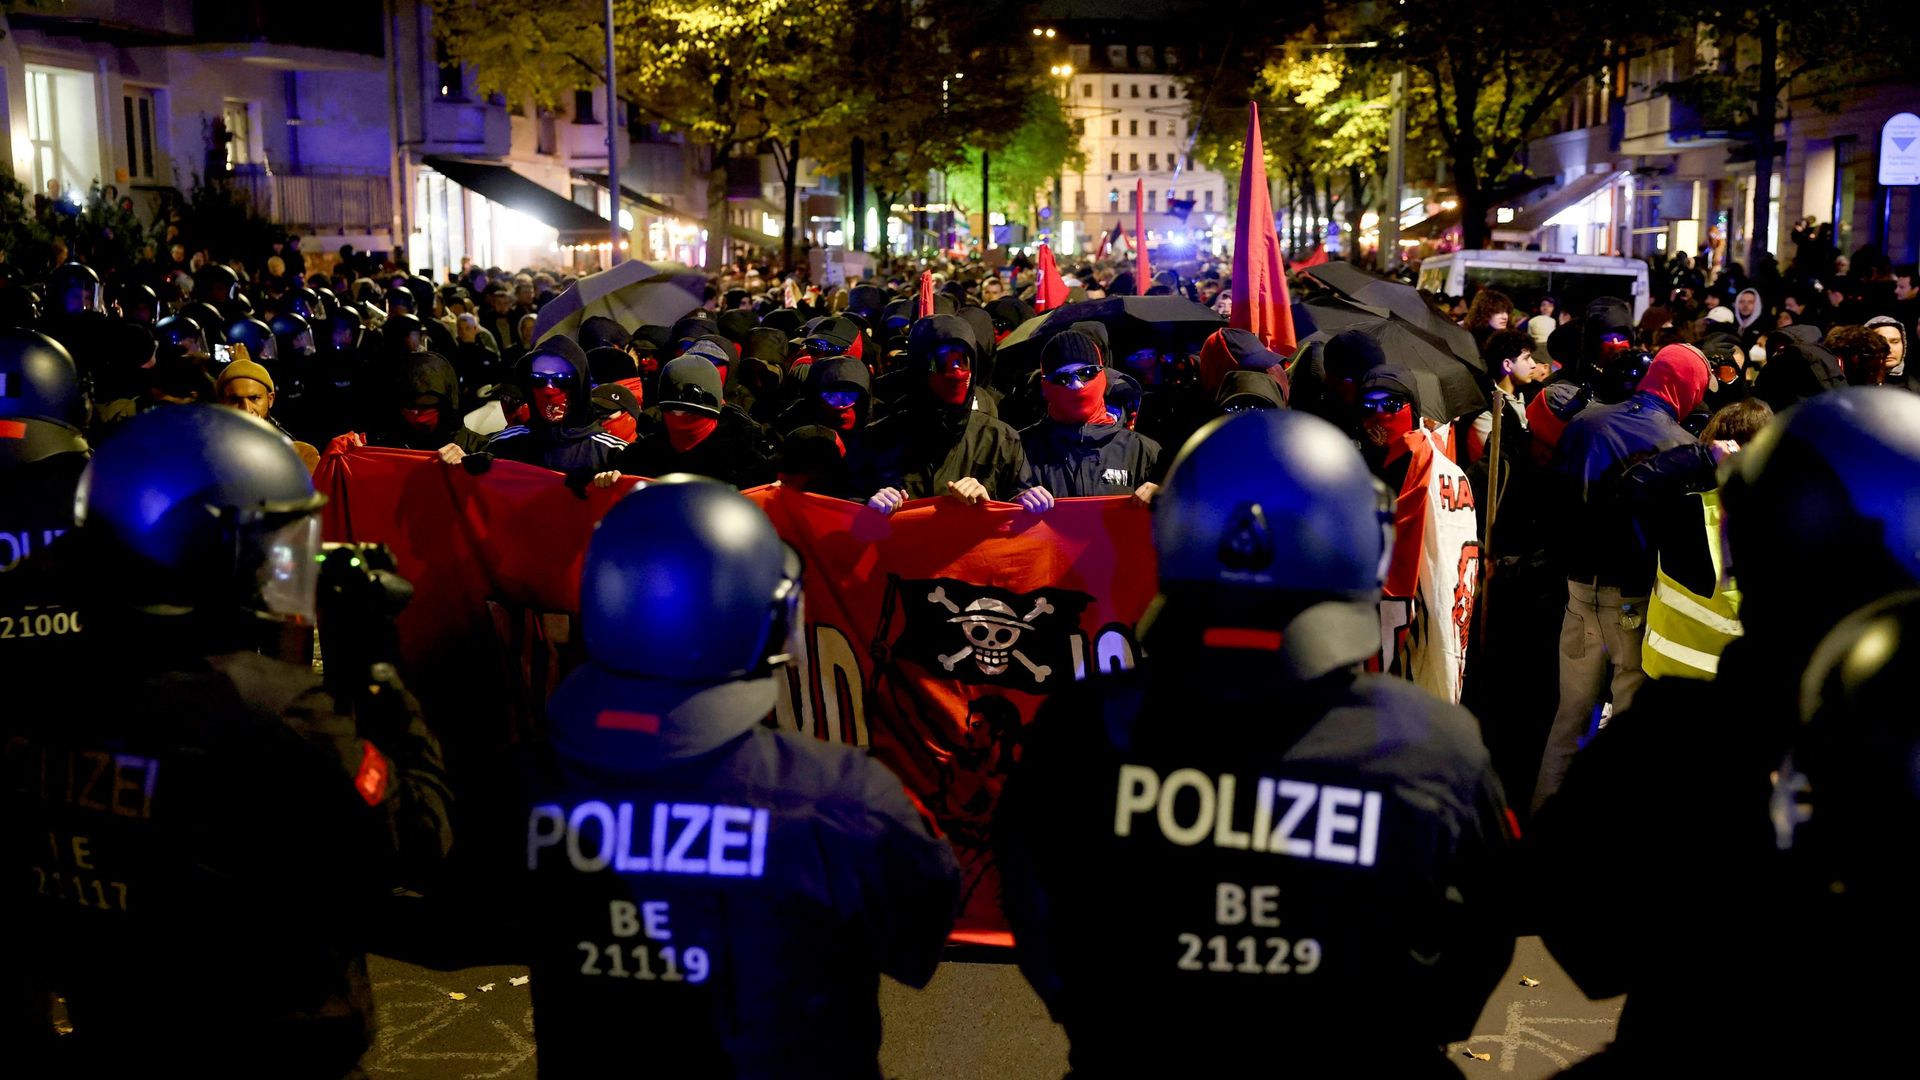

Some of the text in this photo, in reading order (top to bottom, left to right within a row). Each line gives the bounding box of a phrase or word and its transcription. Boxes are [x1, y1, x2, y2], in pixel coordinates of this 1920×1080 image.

[1113, 763, 1383, 867] POLIZEI
[526, 800, 770, 878] POLIZEI
[609, 899, 672, 941] BE
[1215, 881, 1281, 928] BE
[577, 940, 710, 983] 21119
[1176, 932, 1322, 975] 21129
